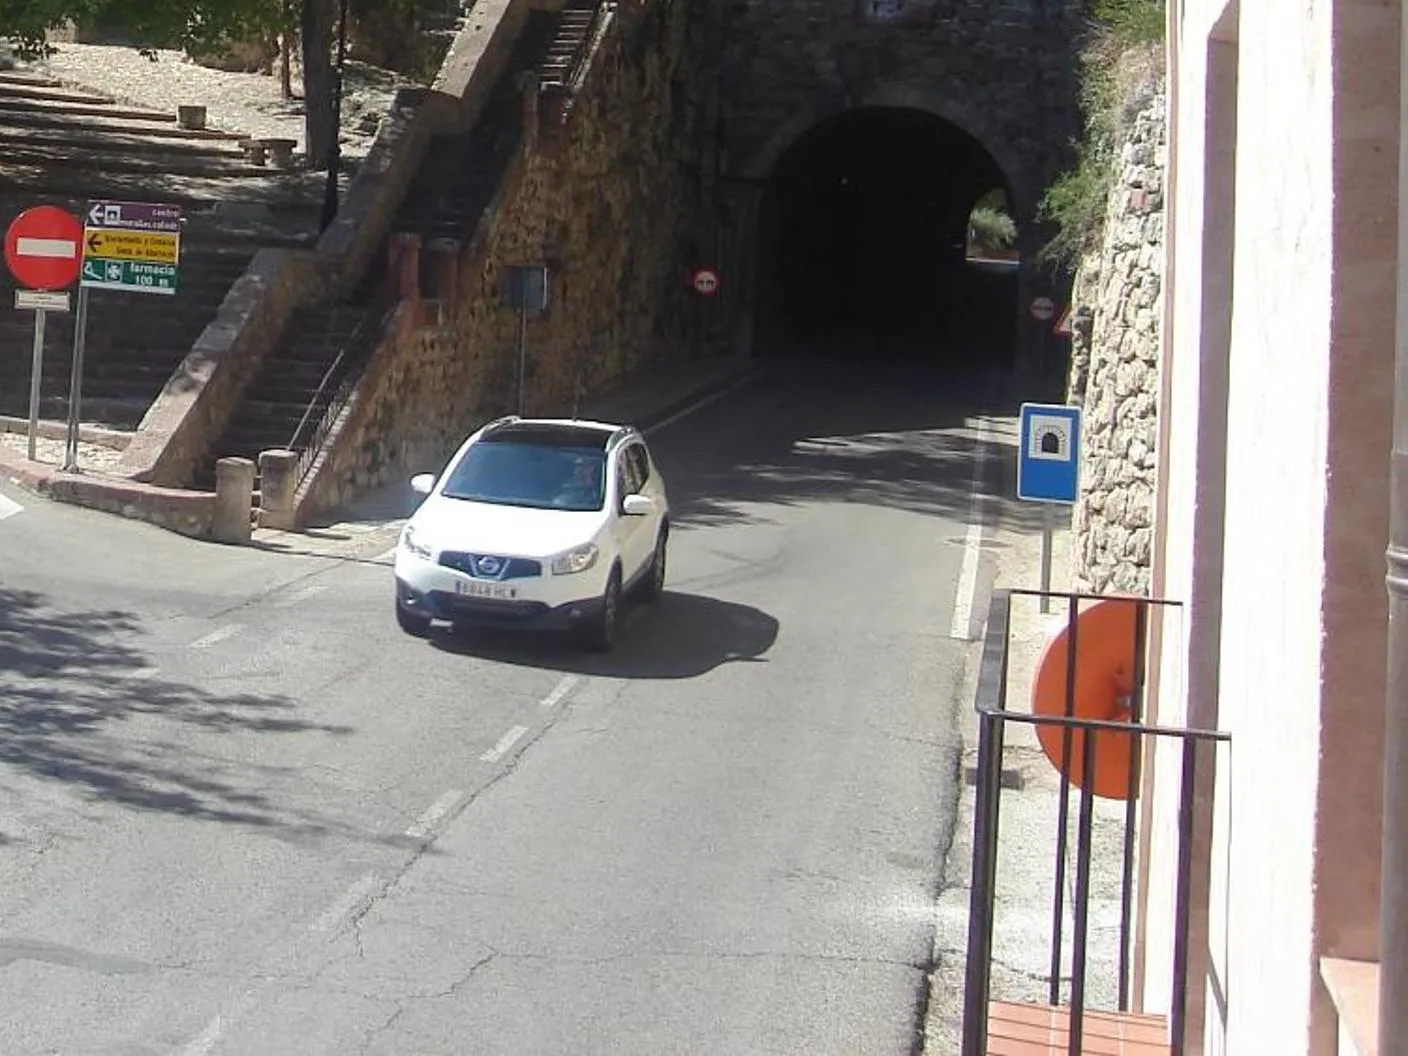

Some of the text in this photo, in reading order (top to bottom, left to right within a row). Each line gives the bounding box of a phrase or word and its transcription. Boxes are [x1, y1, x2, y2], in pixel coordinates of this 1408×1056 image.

[130, 262, 176, 276] farmacia
[135, 275, 169, 287] 100 m
